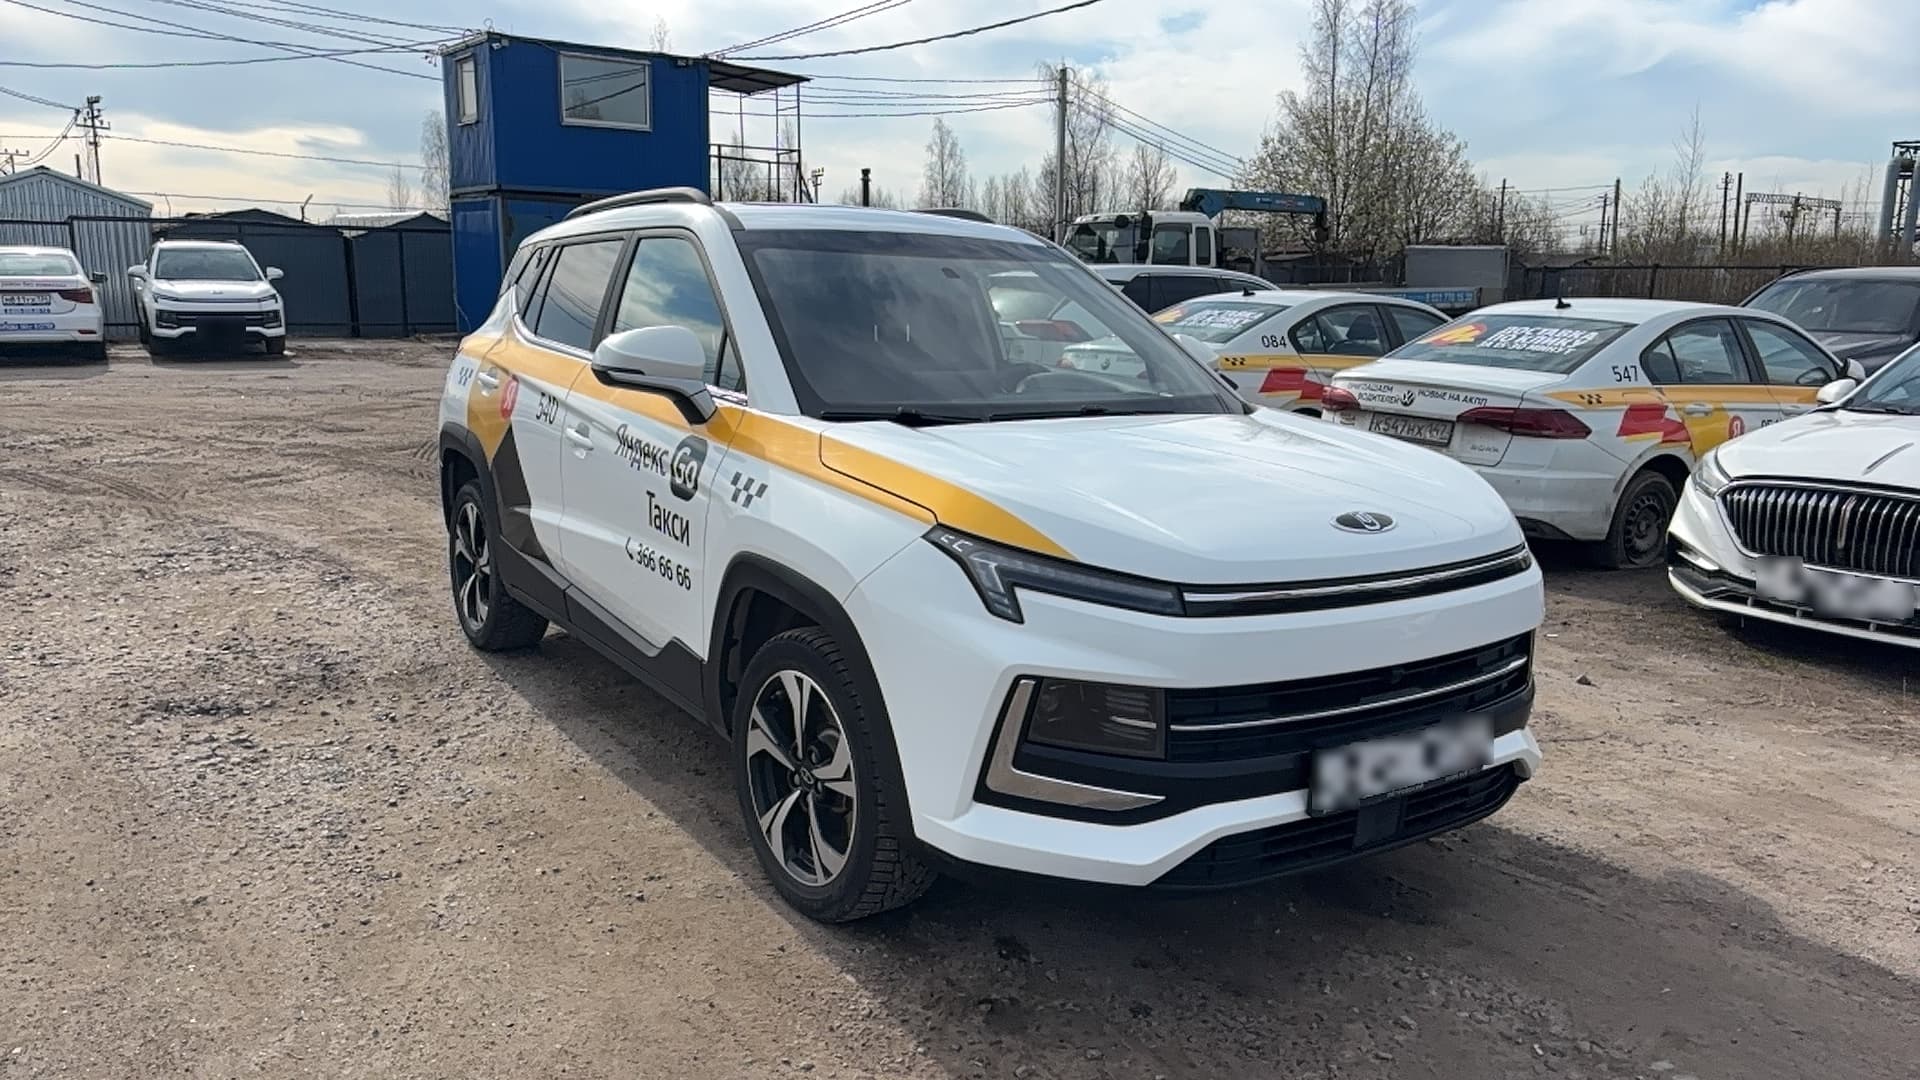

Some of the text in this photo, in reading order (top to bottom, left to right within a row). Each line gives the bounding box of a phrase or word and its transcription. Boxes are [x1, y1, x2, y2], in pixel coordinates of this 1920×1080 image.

[1612, 365, 1638, 383] 547
[536, 391, 559, 424] 540
[1418, 389, 1488, 407] НОВЫЕ НА АКПП
[615, 424, 698, 490] Яндекс Go
[646, 491, 691, 546] Такси
[636, 543, 691, 591] 366 66 66
